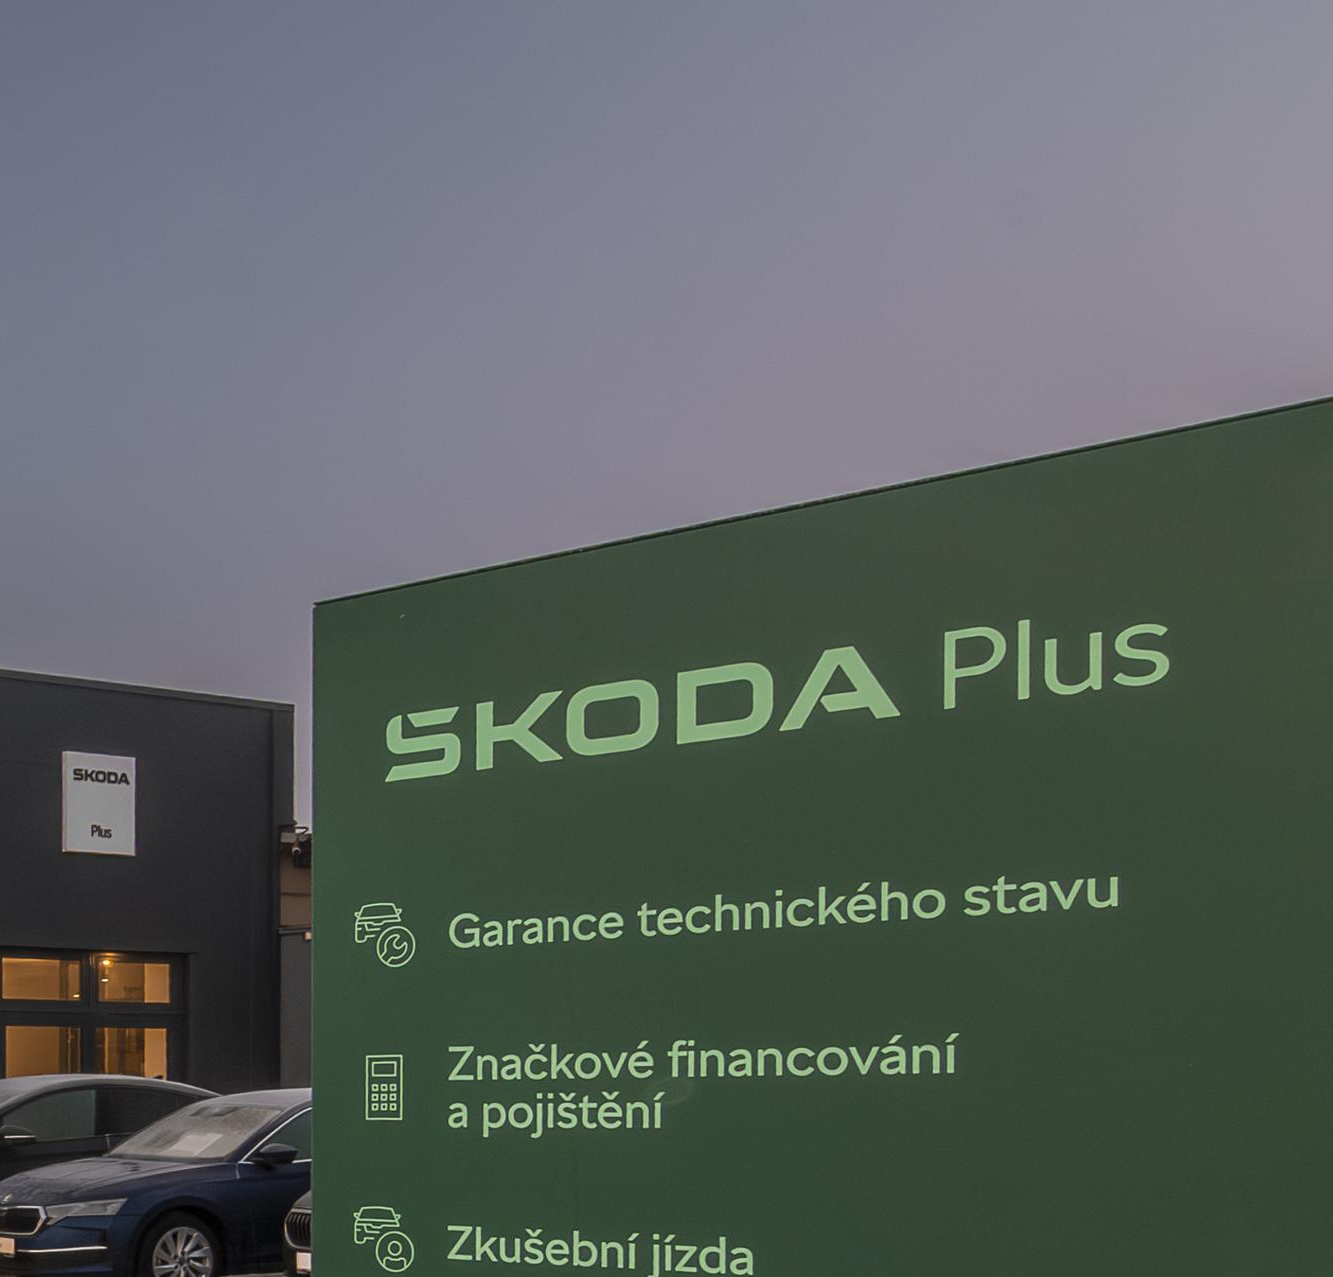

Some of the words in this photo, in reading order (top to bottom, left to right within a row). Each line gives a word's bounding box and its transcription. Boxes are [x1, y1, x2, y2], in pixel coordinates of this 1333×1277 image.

[943, 619, 1170, 710] Plus
[90, 824, 113, 839] Plus
[448, 912, 624, 949] Garance
[636, 881, 946, 937] technického
[963, 875, 1119, 917] stavu
[448, 1040, 654, 1081] Značkové
[667, 1032, 960, 1078] financování
[447, 1102, 468, 1129] a
[482, 1091, 665, 1139] pojištění
[447, 1225, 640, 1270] Zkušební
